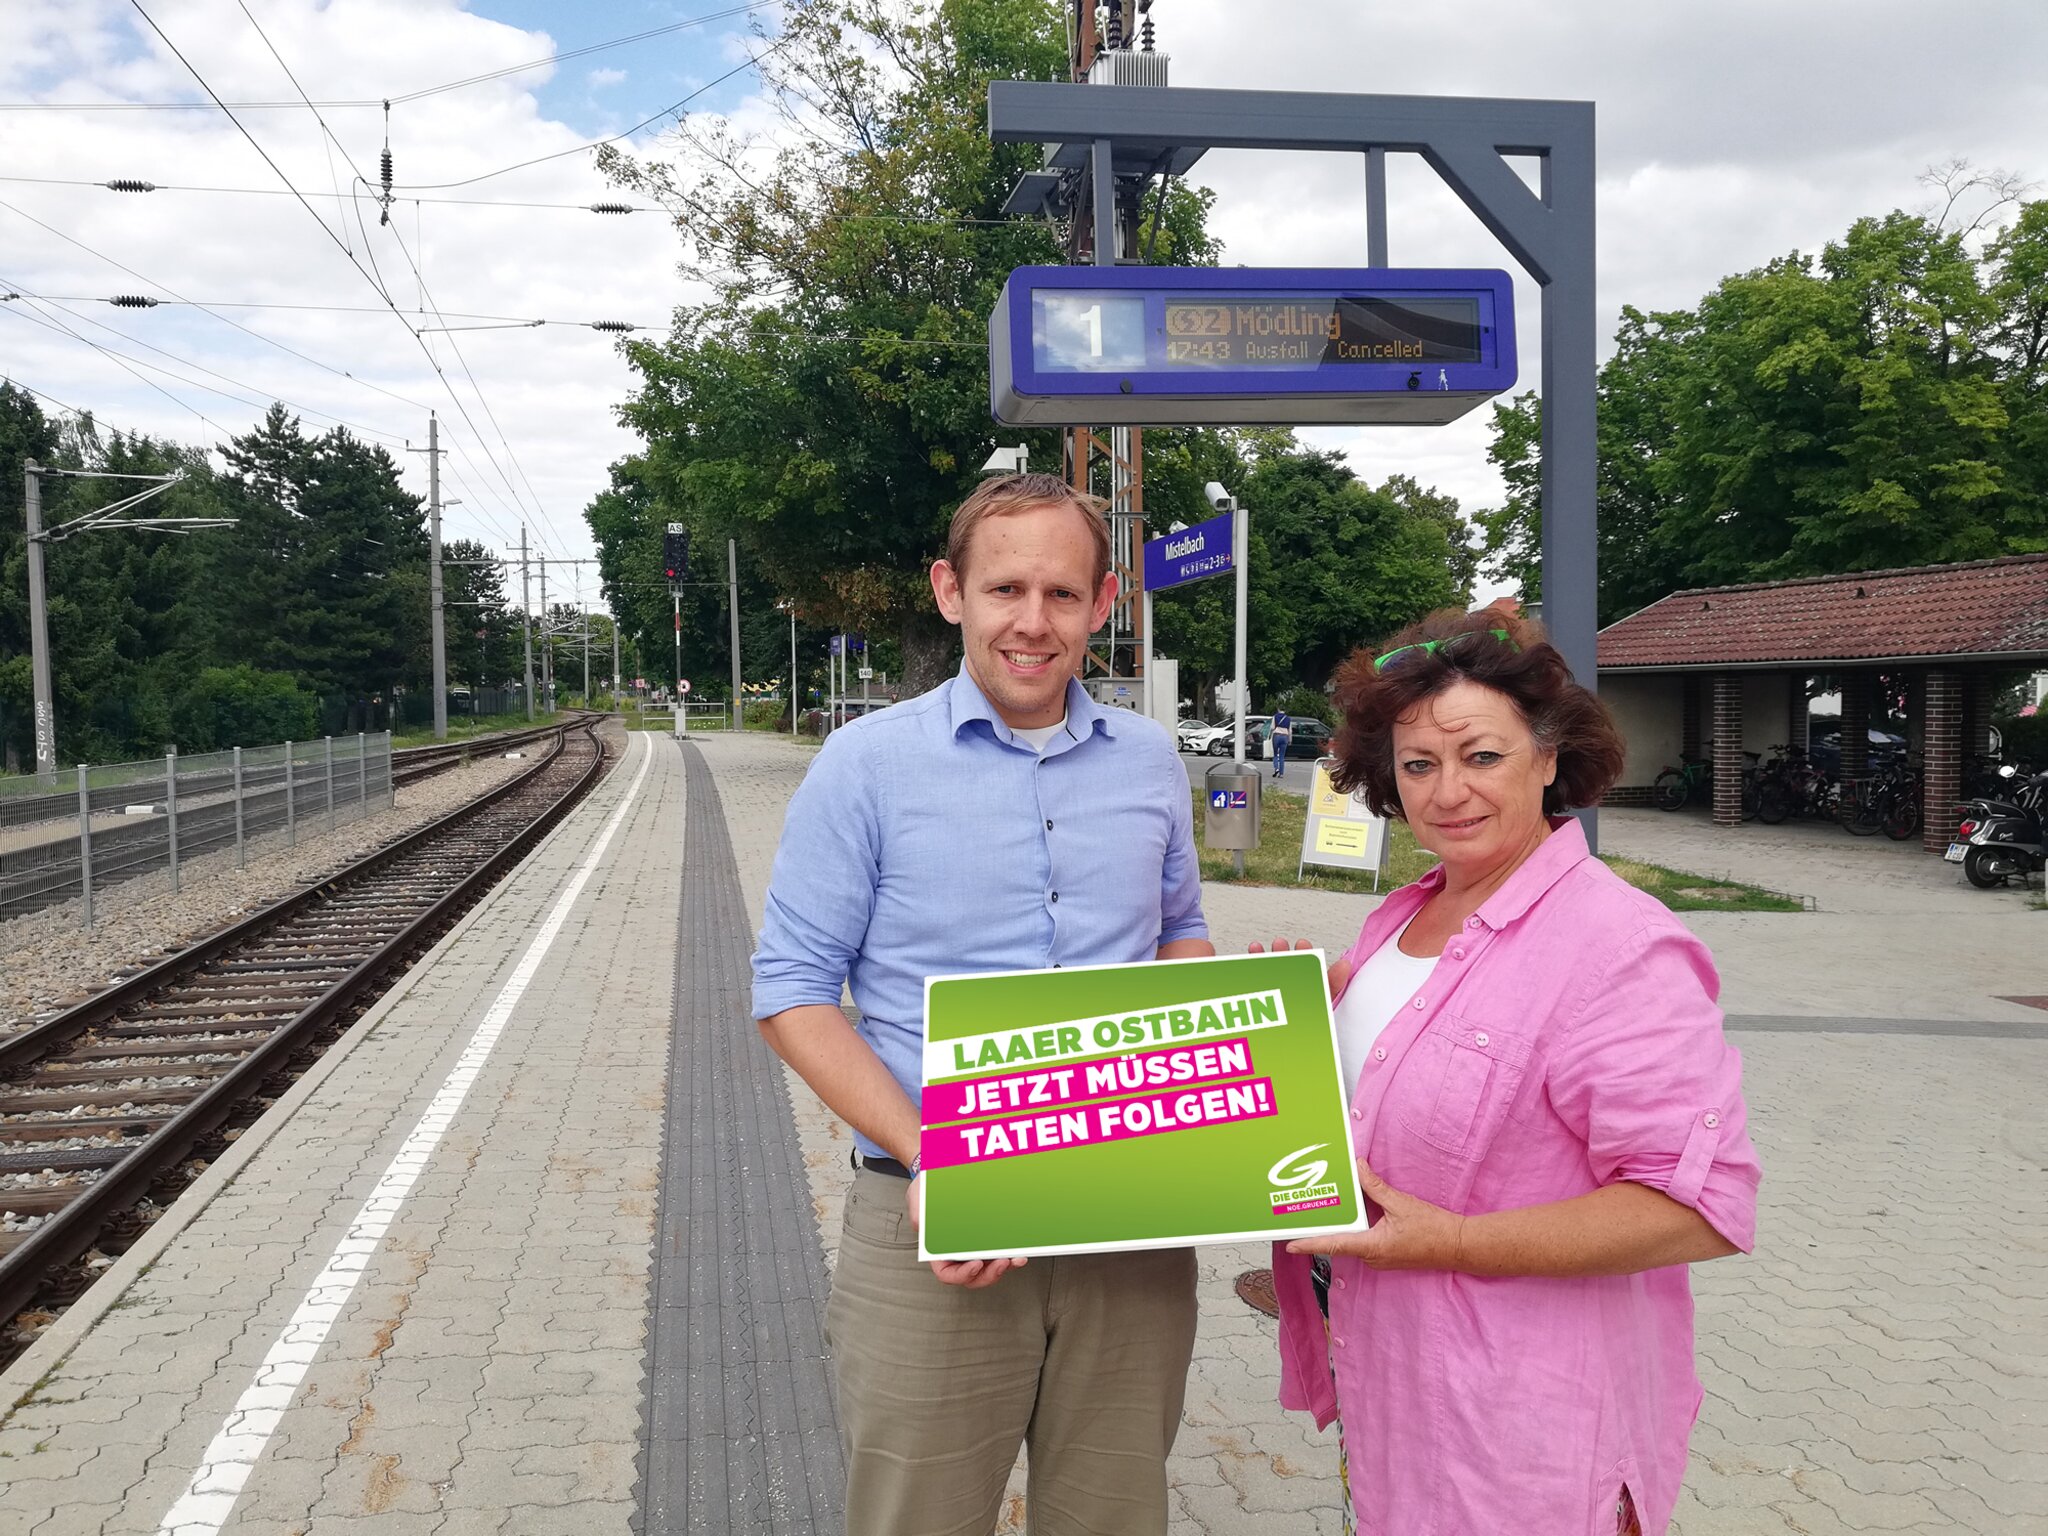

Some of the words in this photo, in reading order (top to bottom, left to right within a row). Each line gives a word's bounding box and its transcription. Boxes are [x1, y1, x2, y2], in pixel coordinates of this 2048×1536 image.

[1080, 305, 1102, 357] 1
[1236, 306, 1341, 340] Mödling
[1167, 341, 1231, 360] 17:43
[1246, 341, 1308, 359] Ausfall
[1338, 340, 1423, 358] Cancelled
[669, 524, 682, 533] AS
[1165, 531, 1205, 561] Mistelbach
[953, 1026, 1083, 1071] LAAER
[1093, 994, 1280, 1048] OSTBAHN
[957, 1070, 1075, 1115] JETZT
[1086, 1043, 1248, 1095] MÜSSEN
[959, 1110, 1089, 1158] TATEN
[1098, 1082, 1271, 1137] FOLGEN!
[1272, 1192, 1291, 1203] DIE
[1291, 1185, 1336, 1200] GRÜNEN
